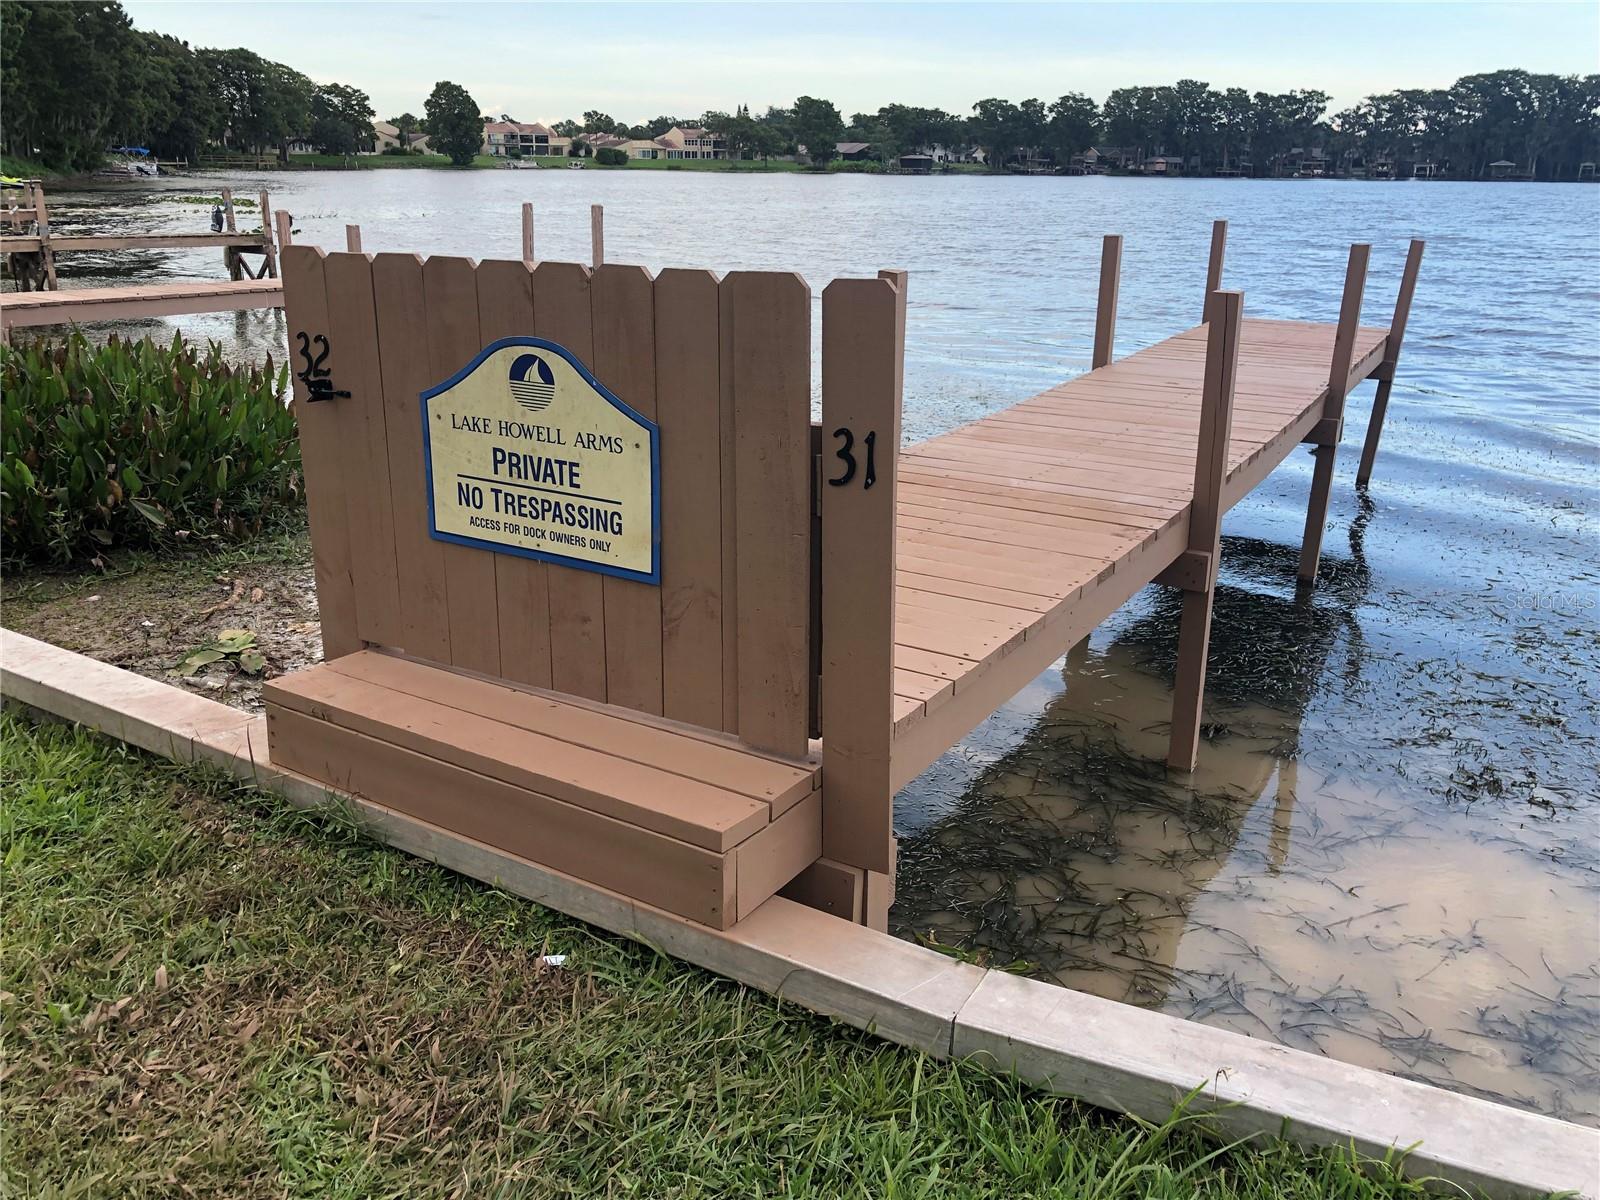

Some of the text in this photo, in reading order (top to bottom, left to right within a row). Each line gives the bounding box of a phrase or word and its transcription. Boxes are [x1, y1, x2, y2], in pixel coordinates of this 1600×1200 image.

[297, 331, 331, 378] 32
[451, 413, 623, 454] LAKE HOWELL ARMS
[492, 447, 581, 489] PRIVATE
[828, 427, 876, 490] 31
[457, 482, 623, 536] NO TRESPASSING
[469, 516, 612, 553] ACCESS FOR DOCK OWNERS ONLY
